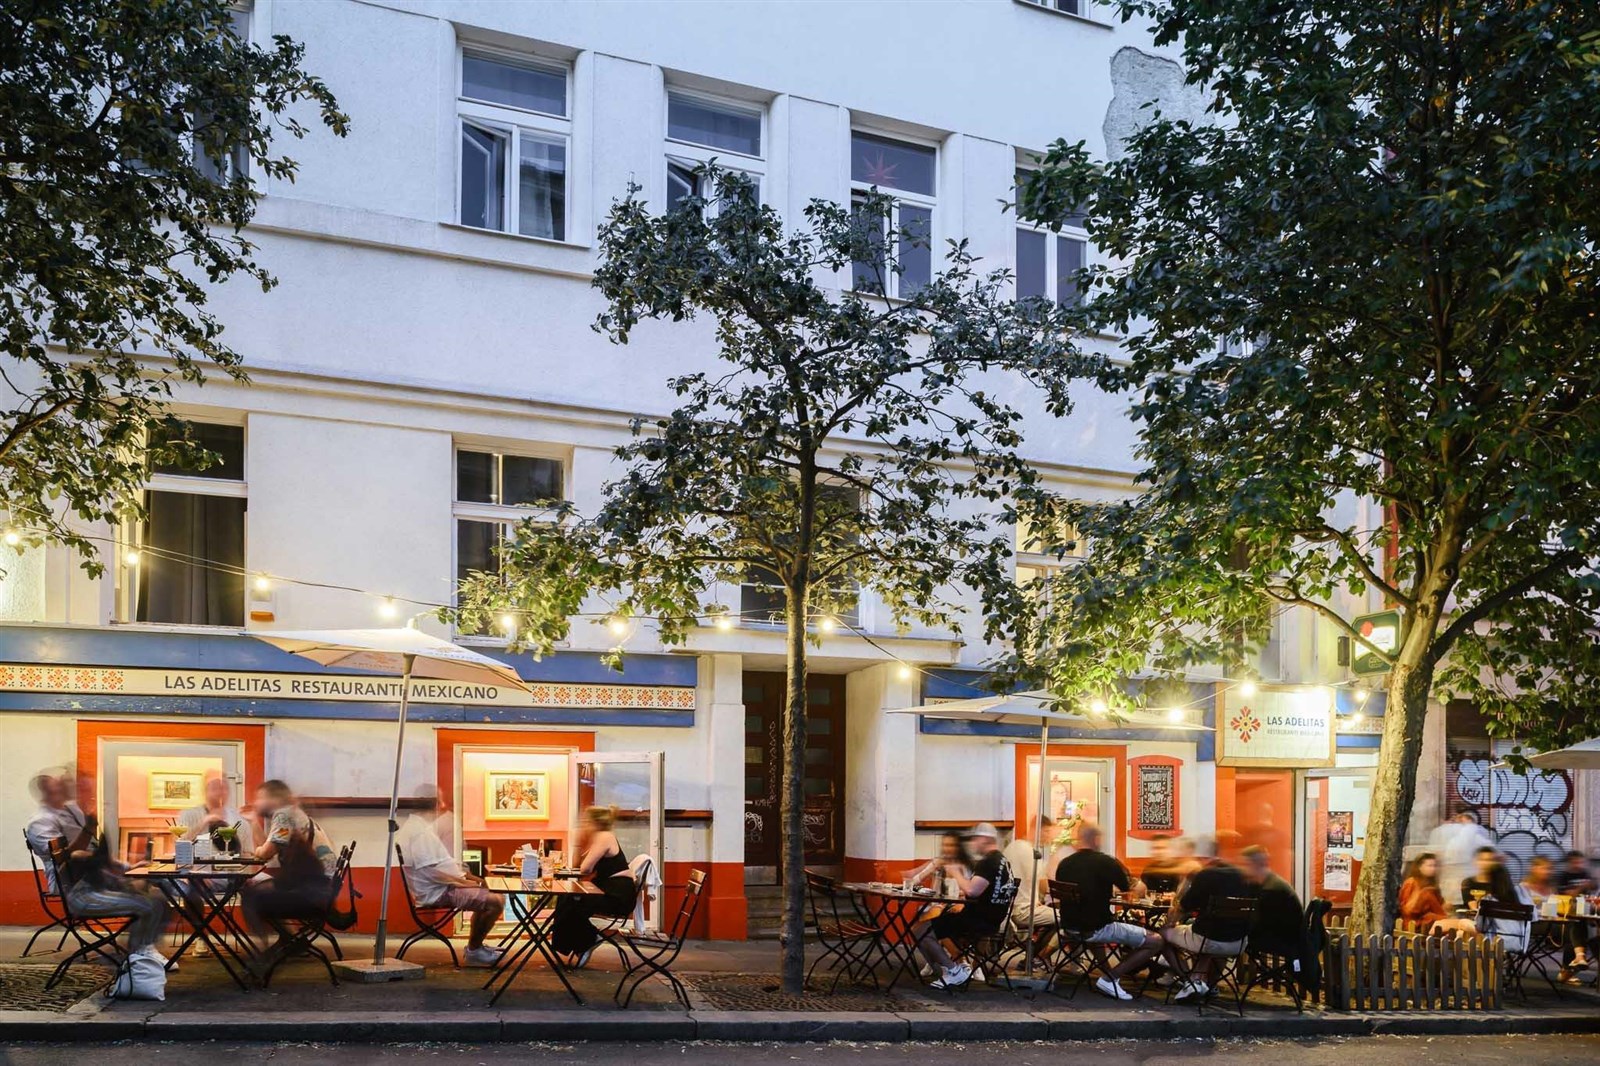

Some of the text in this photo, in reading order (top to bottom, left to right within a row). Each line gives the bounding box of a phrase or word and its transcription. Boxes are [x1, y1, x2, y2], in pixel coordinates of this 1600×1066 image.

[165, 675, 196, 690] LAS
[201, 676, 281, 692] ADELITAS
[412, 684, 498, 699] MEXICANO
[1267, 716, 1325, 727] LAS ADELITAS
